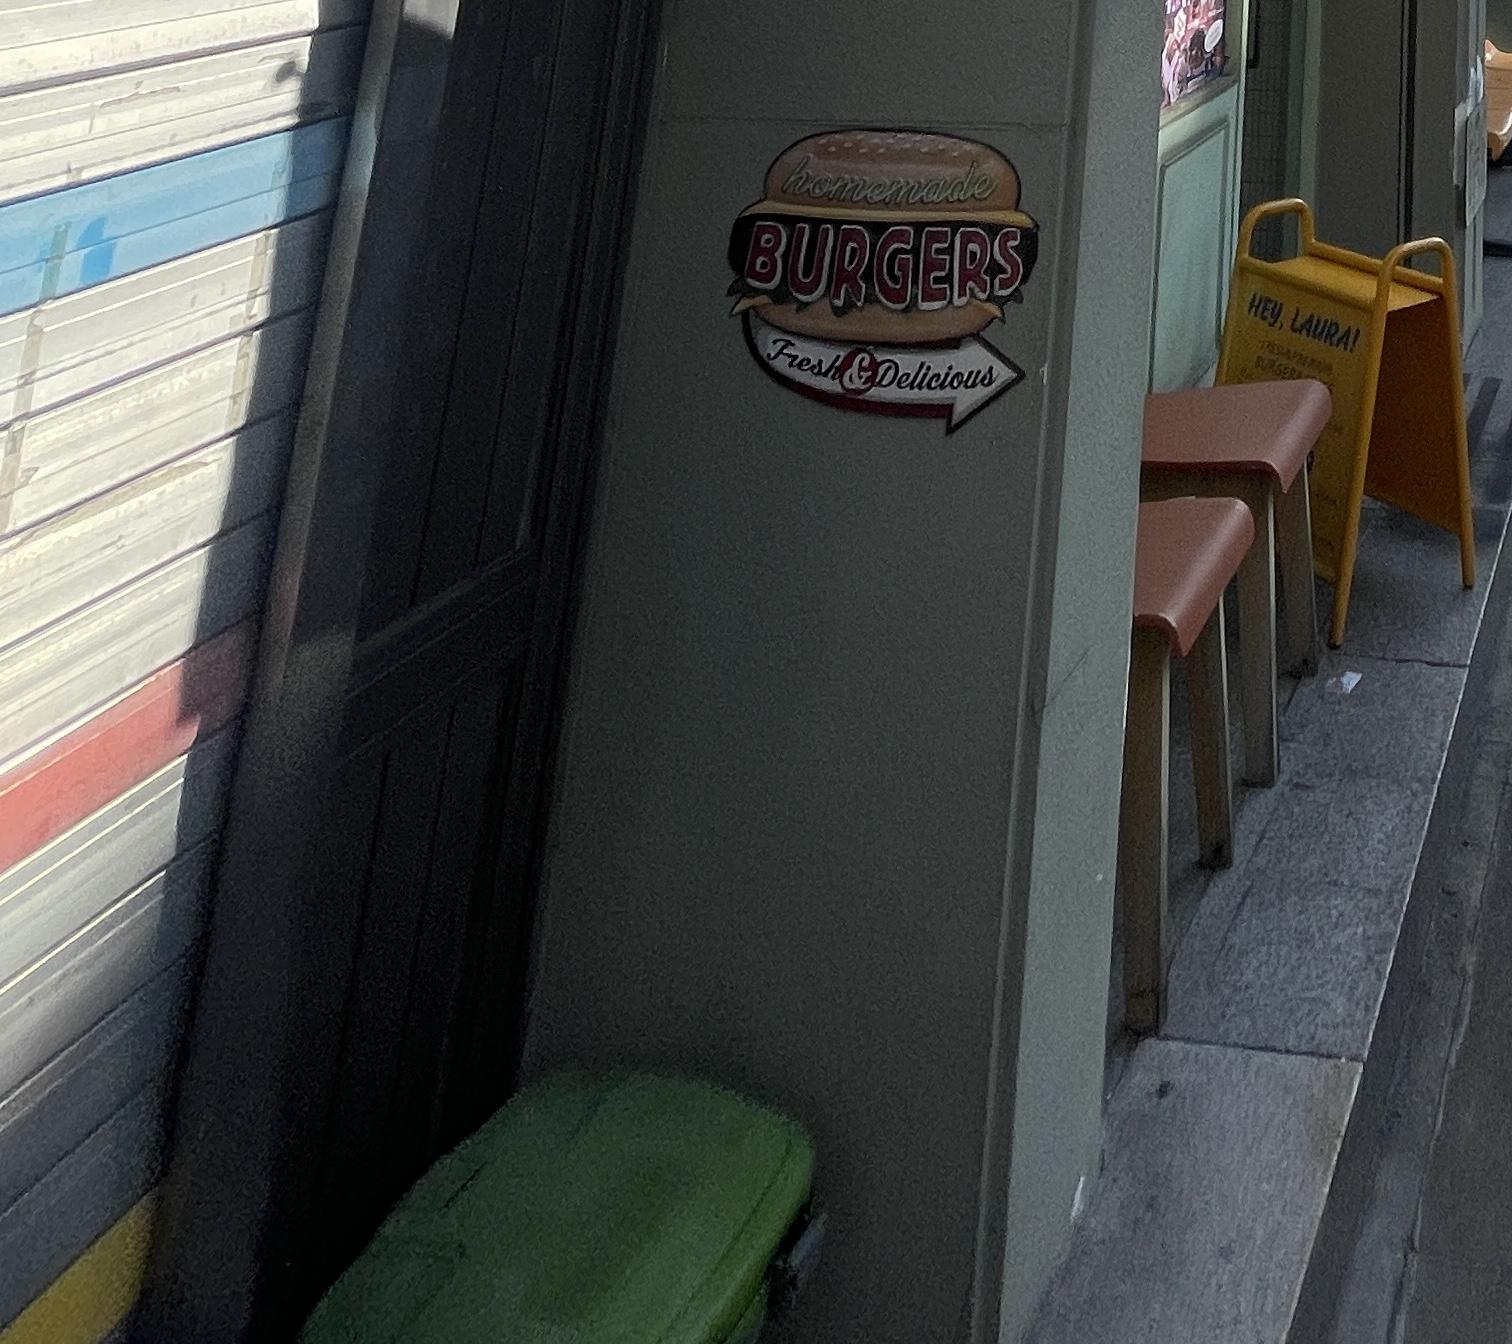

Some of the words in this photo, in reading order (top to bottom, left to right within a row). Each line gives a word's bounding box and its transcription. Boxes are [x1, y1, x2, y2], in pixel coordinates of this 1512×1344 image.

[781, 153, 998, 205] homemade
[744, 220, 1024, 311] BURGERS
[1247, 292, 1284, 330] HEY,
[1290, 306, 1361, 353] LAURA!
[766, 338, 841, 381] Fresh
[874, 358, 999, 391] Delicious
